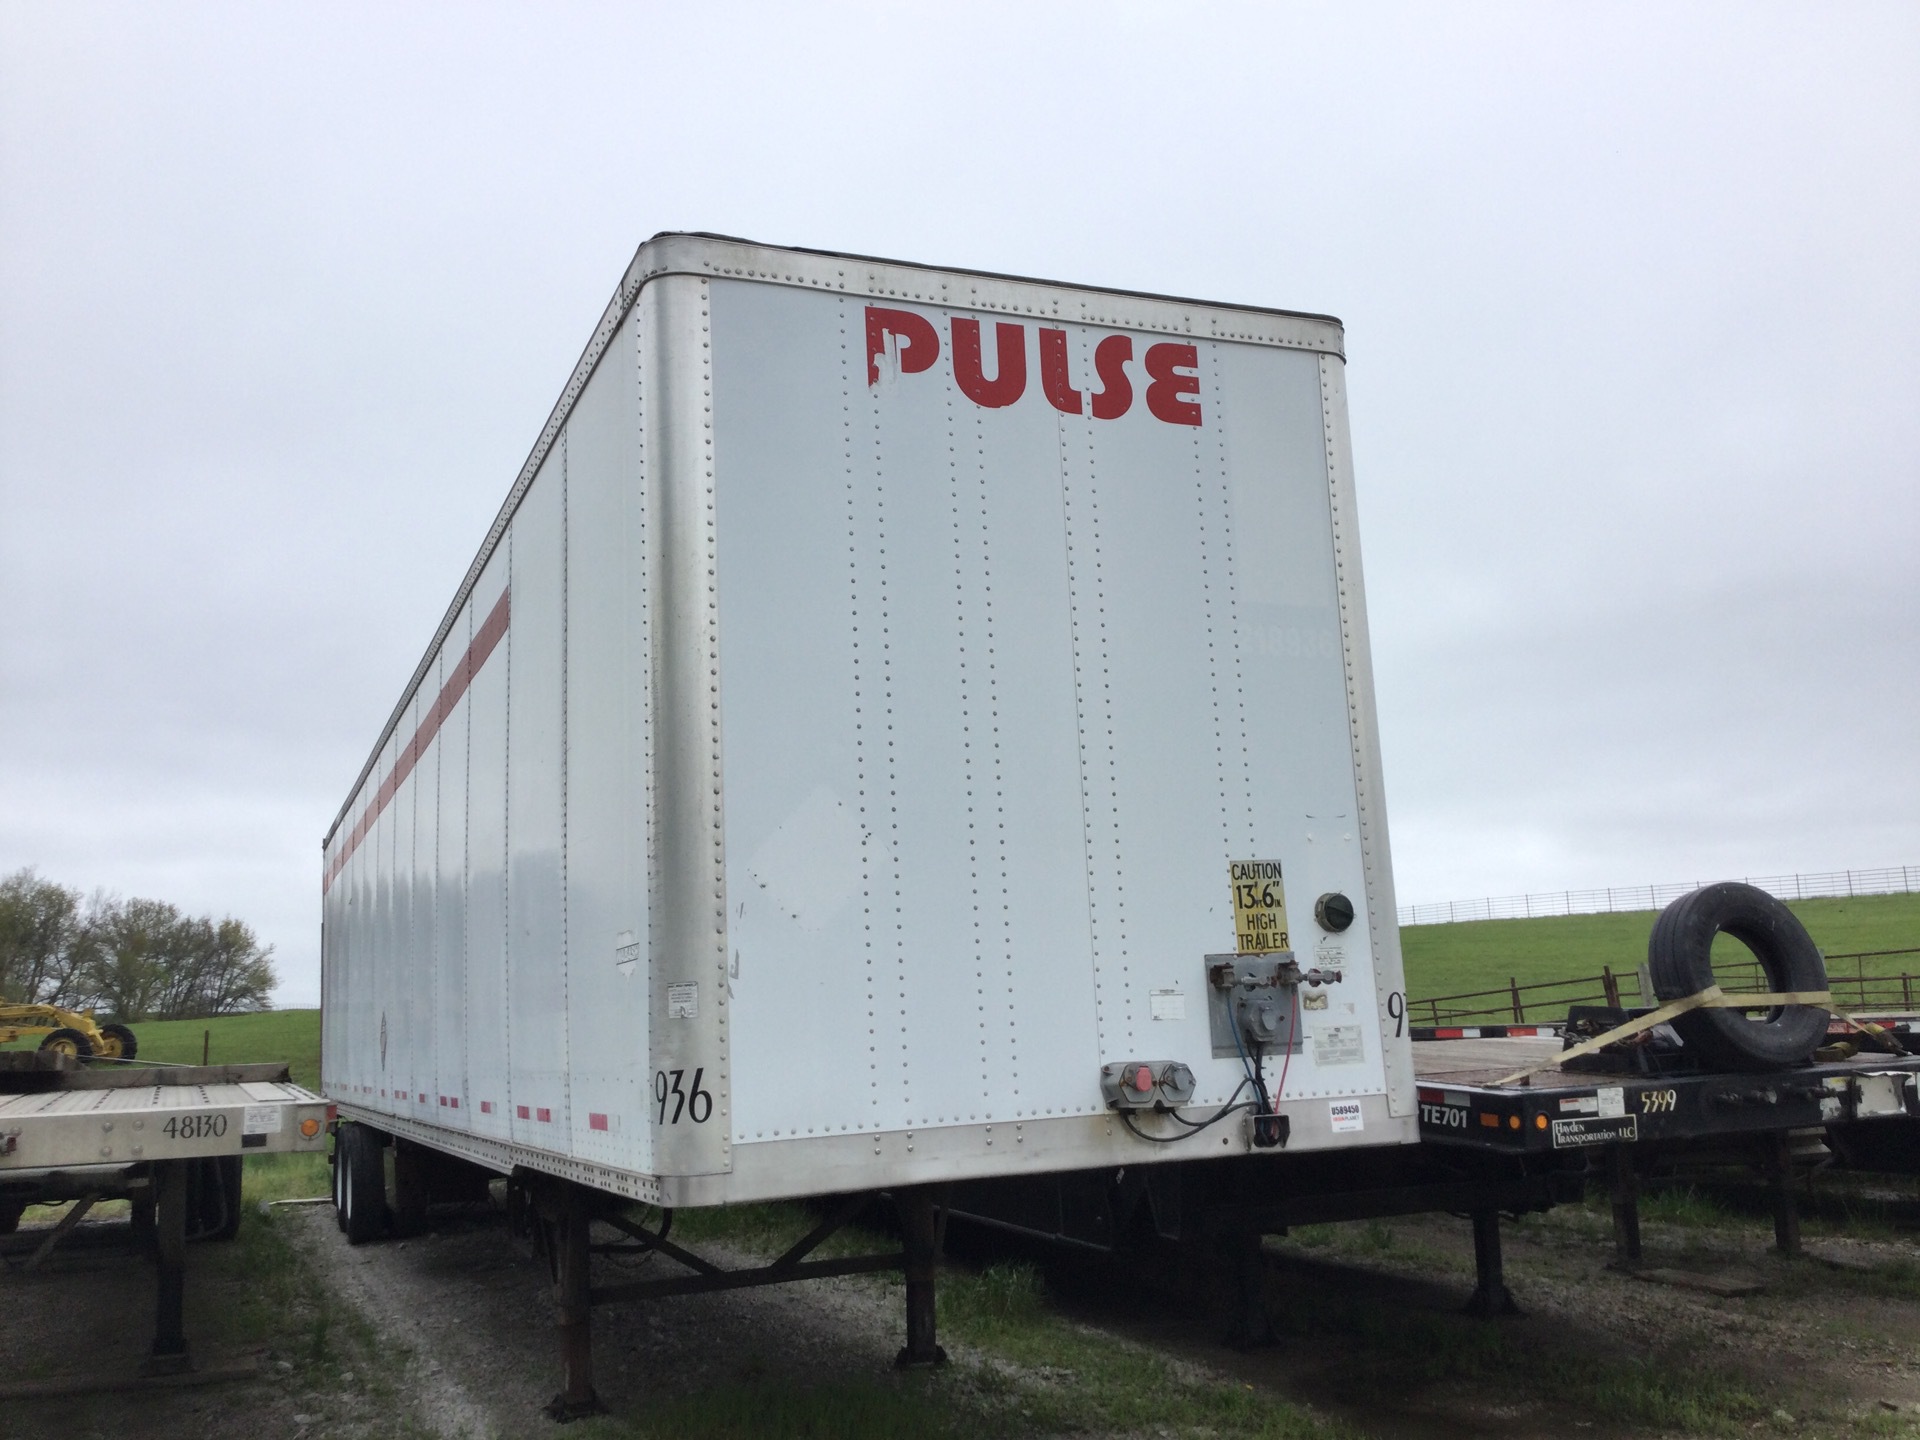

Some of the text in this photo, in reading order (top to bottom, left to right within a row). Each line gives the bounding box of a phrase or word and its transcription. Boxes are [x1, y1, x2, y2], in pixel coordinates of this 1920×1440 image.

[864, 305, 1203, 427] PULSE
[1231, 862, 1282, 881] CAUTION
[1246, 912, 1277, 930] HIGH
[1238, 931, 1289, 951] TRAILER
[1387, 991, 1410, 1037] 9
[655, 1067, 713, 1125] 936
[1641, 1089, 1677, 1113] 5399
[162, 1113, 228, 1139] 48130
[1420, 1104, 1468, 1128] TE701
[1618, 1126, 1635, 1138] LLC
